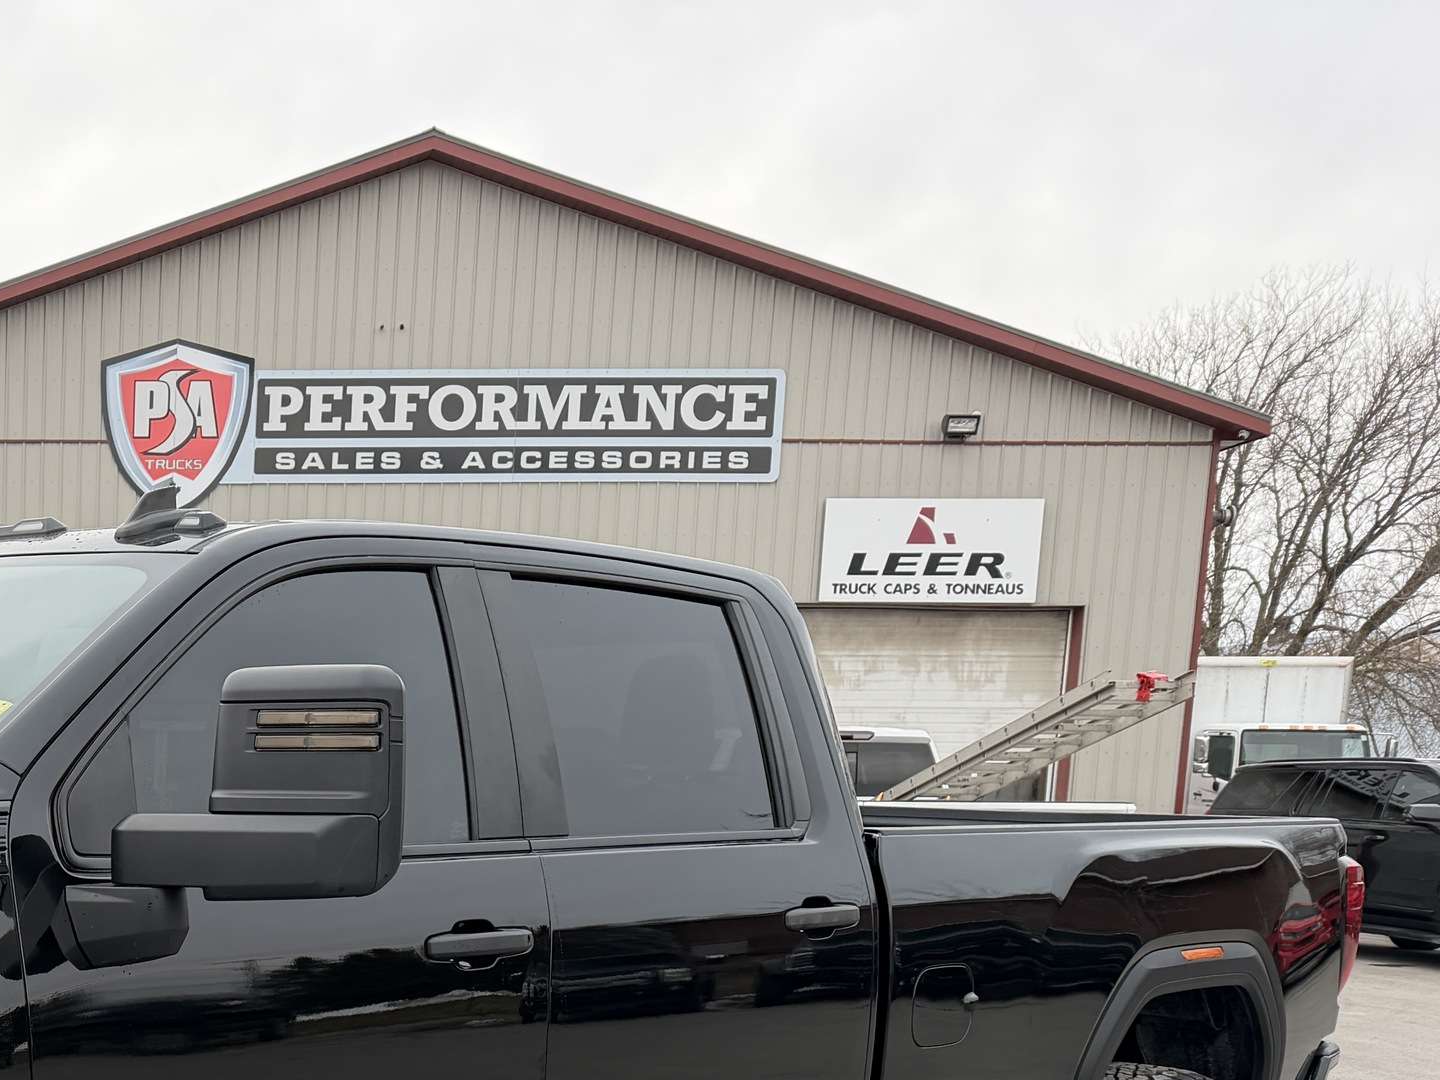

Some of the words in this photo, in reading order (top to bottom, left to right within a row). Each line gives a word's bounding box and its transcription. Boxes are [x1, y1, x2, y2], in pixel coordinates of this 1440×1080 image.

[133, 369, 220, 456] PSA
[262, 384, 769, 432] PERFORMANCE
[144, 459, 203, 471] TRUCKS
[274, 451, 402, 470] SALES
[419, 451, 444, 470] &
[460, 450, 750, 470] ACCESSORIES
[846, 552, 1005, 579] LEER
[832, 583, 877, 595] TRUCK
[883, 583, 921, 595] CAPS
[926, 583, 938, 595] &
[946, 583, 1025, 595] TONNEAUS
